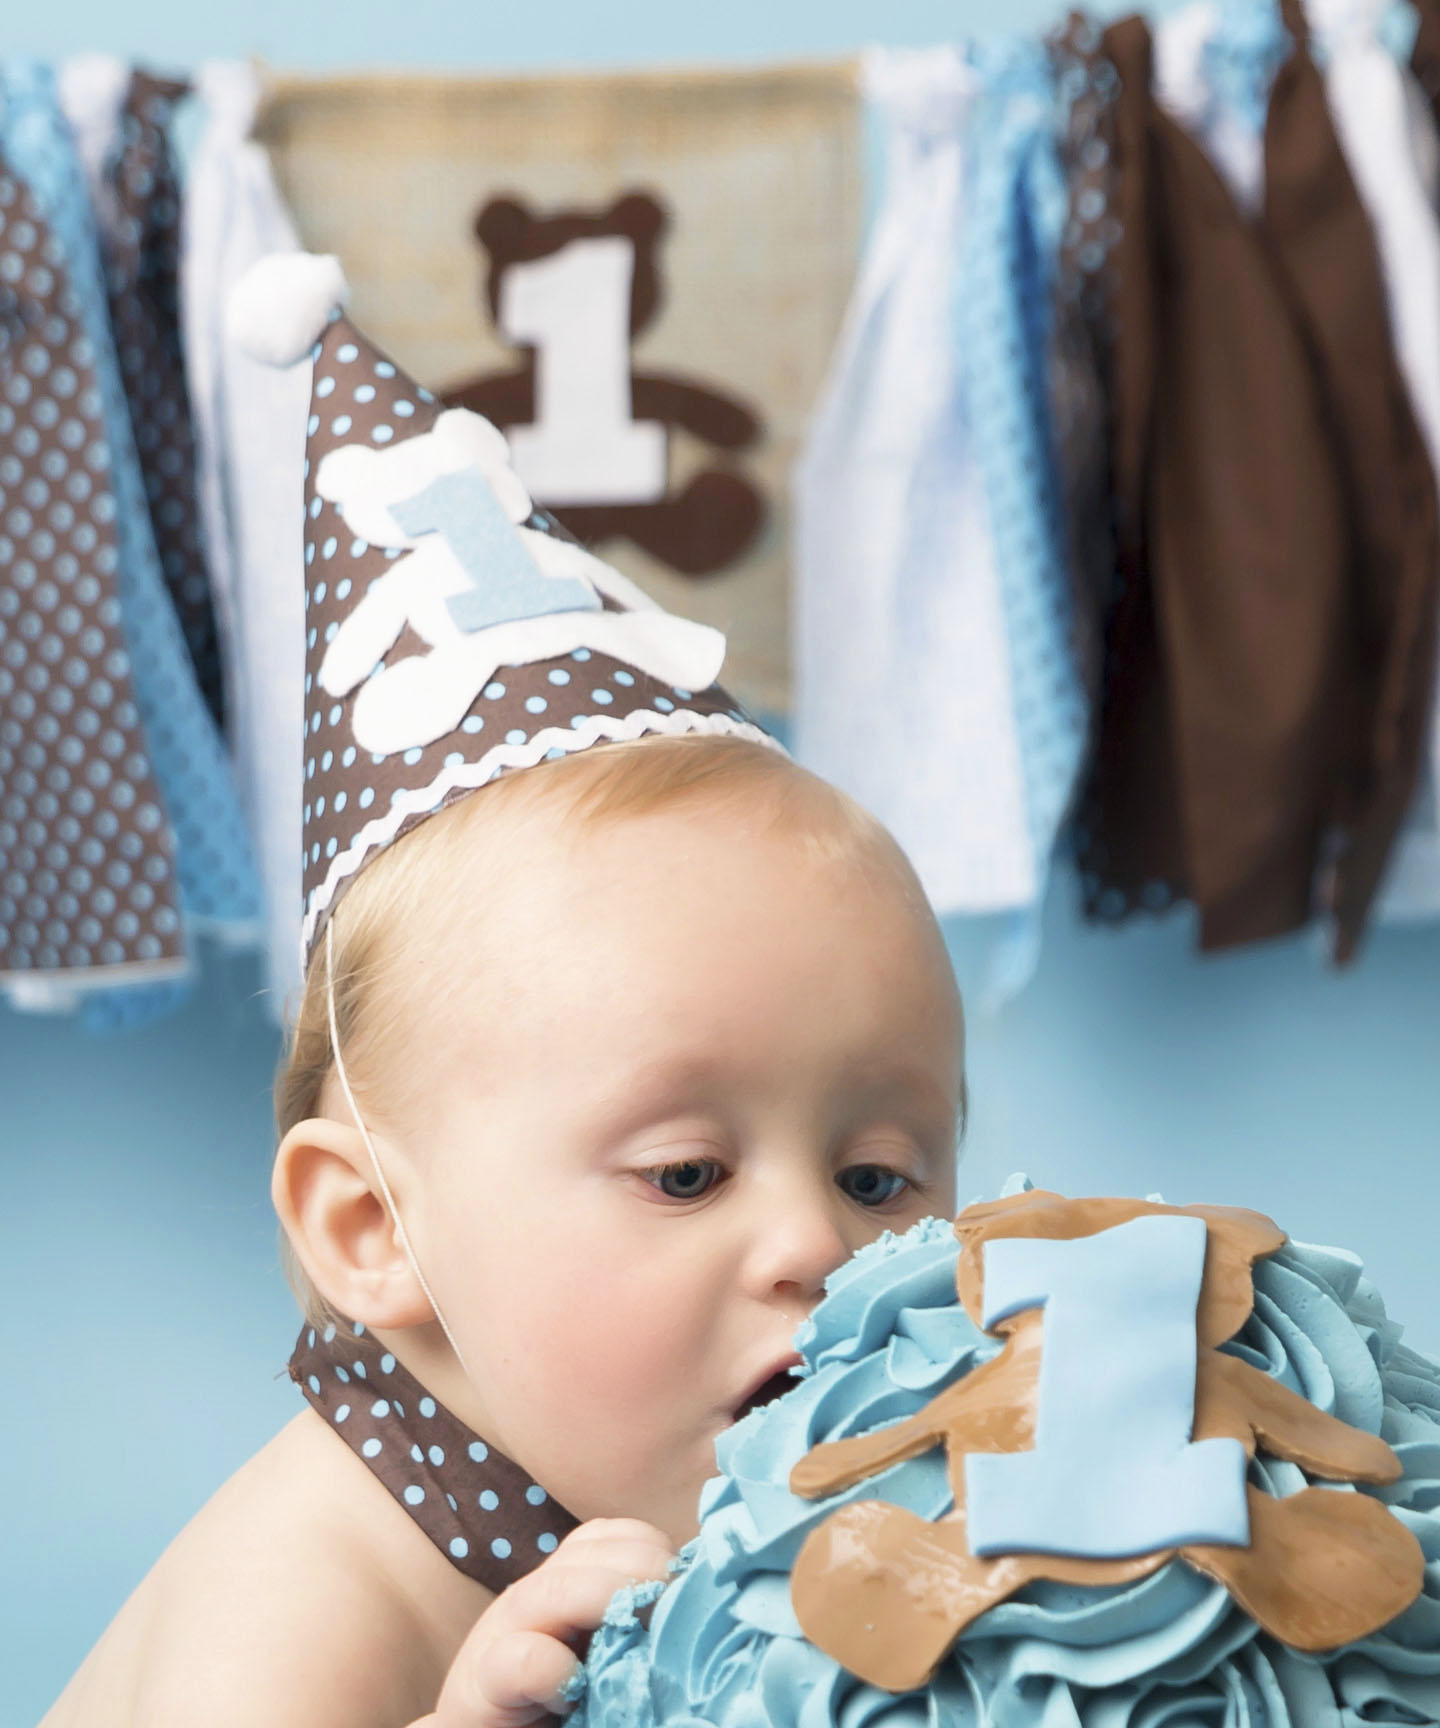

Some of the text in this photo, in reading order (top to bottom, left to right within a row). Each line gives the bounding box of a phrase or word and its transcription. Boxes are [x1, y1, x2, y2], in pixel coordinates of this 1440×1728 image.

[500, 235, 667, 507] 1
[387, 465, 603, 634] 1
[964, 1214, 1250, 1559] 1
